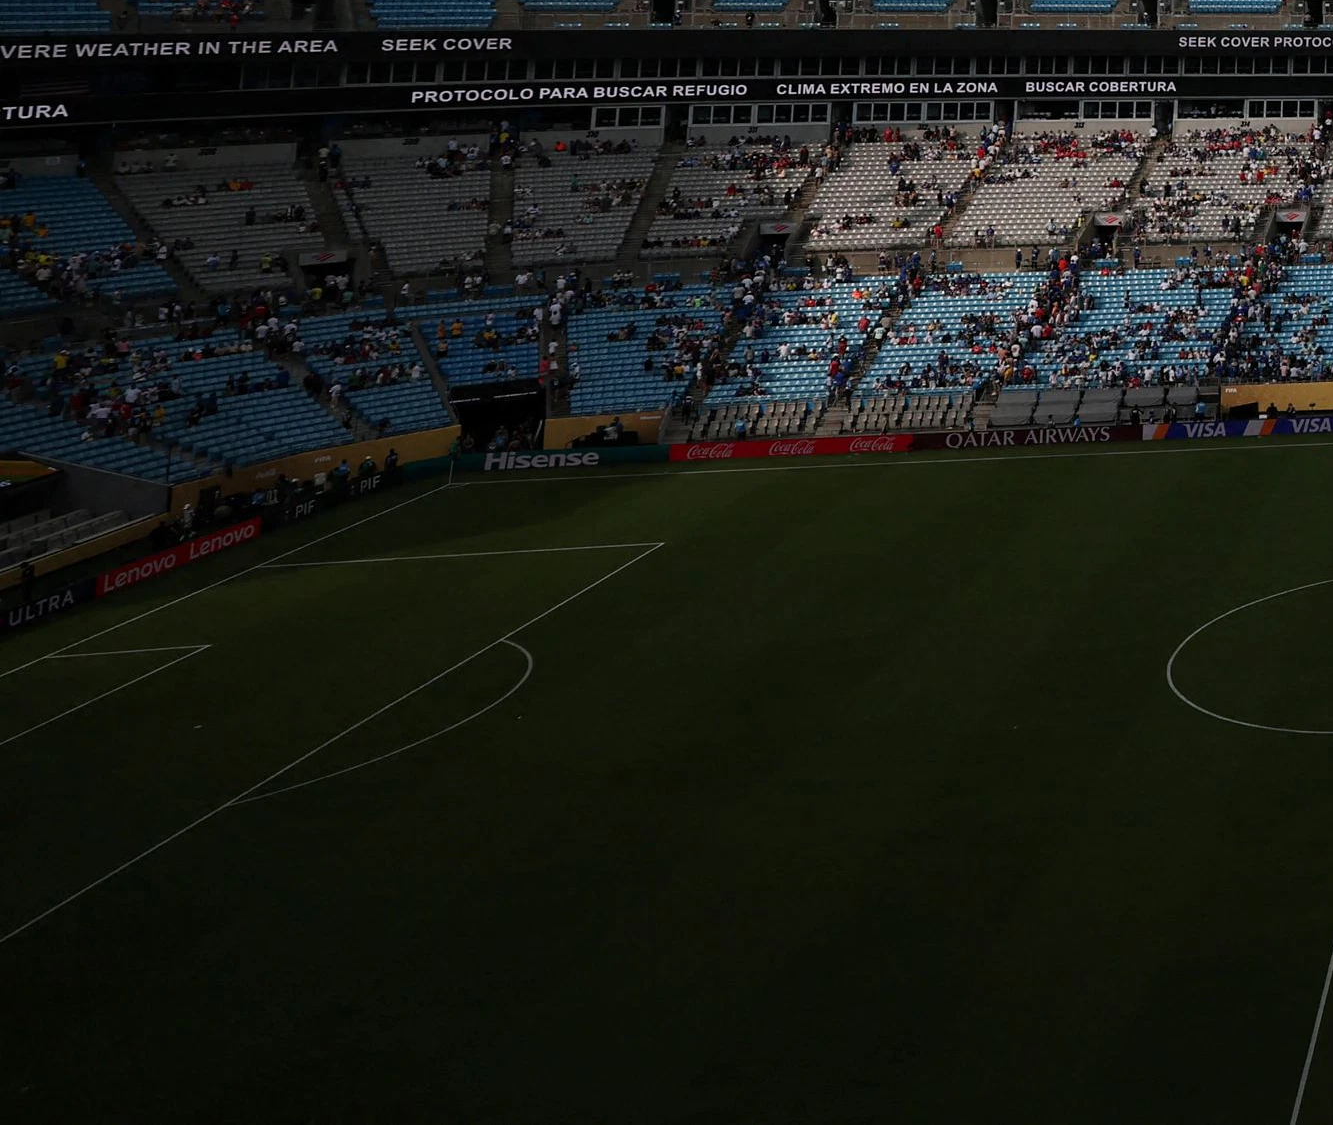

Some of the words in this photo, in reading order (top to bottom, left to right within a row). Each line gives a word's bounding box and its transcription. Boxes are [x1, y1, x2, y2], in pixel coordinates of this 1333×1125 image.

[75, 42, 191, 58] WEATHER
[198, 41, 220, 55] IN
[228, 40, 272, 54] THE
[277, 39, 338, 53] AREA
[381, 38, 437, 52] SEEK
[443, 37, 512, 51] COVER
[1178, 36, 1217, 48] SEEK
[1220, 36, 1270, 48] COVER
[411, 88, 534, 103] PROTOCOLO
[539, 87, 589, 100] PARA
[593, 85, 667, 98] BUSCAR
[672, 84, 748, 97] REFUGIO
[776, 83, 826, 95] CLIMA
[830, 82, 905, 95] EXTREMO
[909, 82, 930, 94] EN
[934, 82, 954, 94] LA
[956, 82, 998, 93] ZONA
[1025, 81, 1085, 93] BUSCAR
[1088, 81, 1177, 92] COBERTURA
[2, 104, 69, 120] TURA
[1183, 422, 1227, 438] VISA
[1288, 417, 1332, 434] VISA
[946, 431, 1016, 449] QATAR
[1024, 426, 1111, 445] AIRWAYS
[483, 451, 600, 471] Hisense
[360, 474, 382, 494] PIF
[295, 499, 317, 519] PIF
[188, 523, 256, 562] Lenovo
[103, 553, 177, 593] Lenovo
[8, 589, 76, 627] ULTRA
